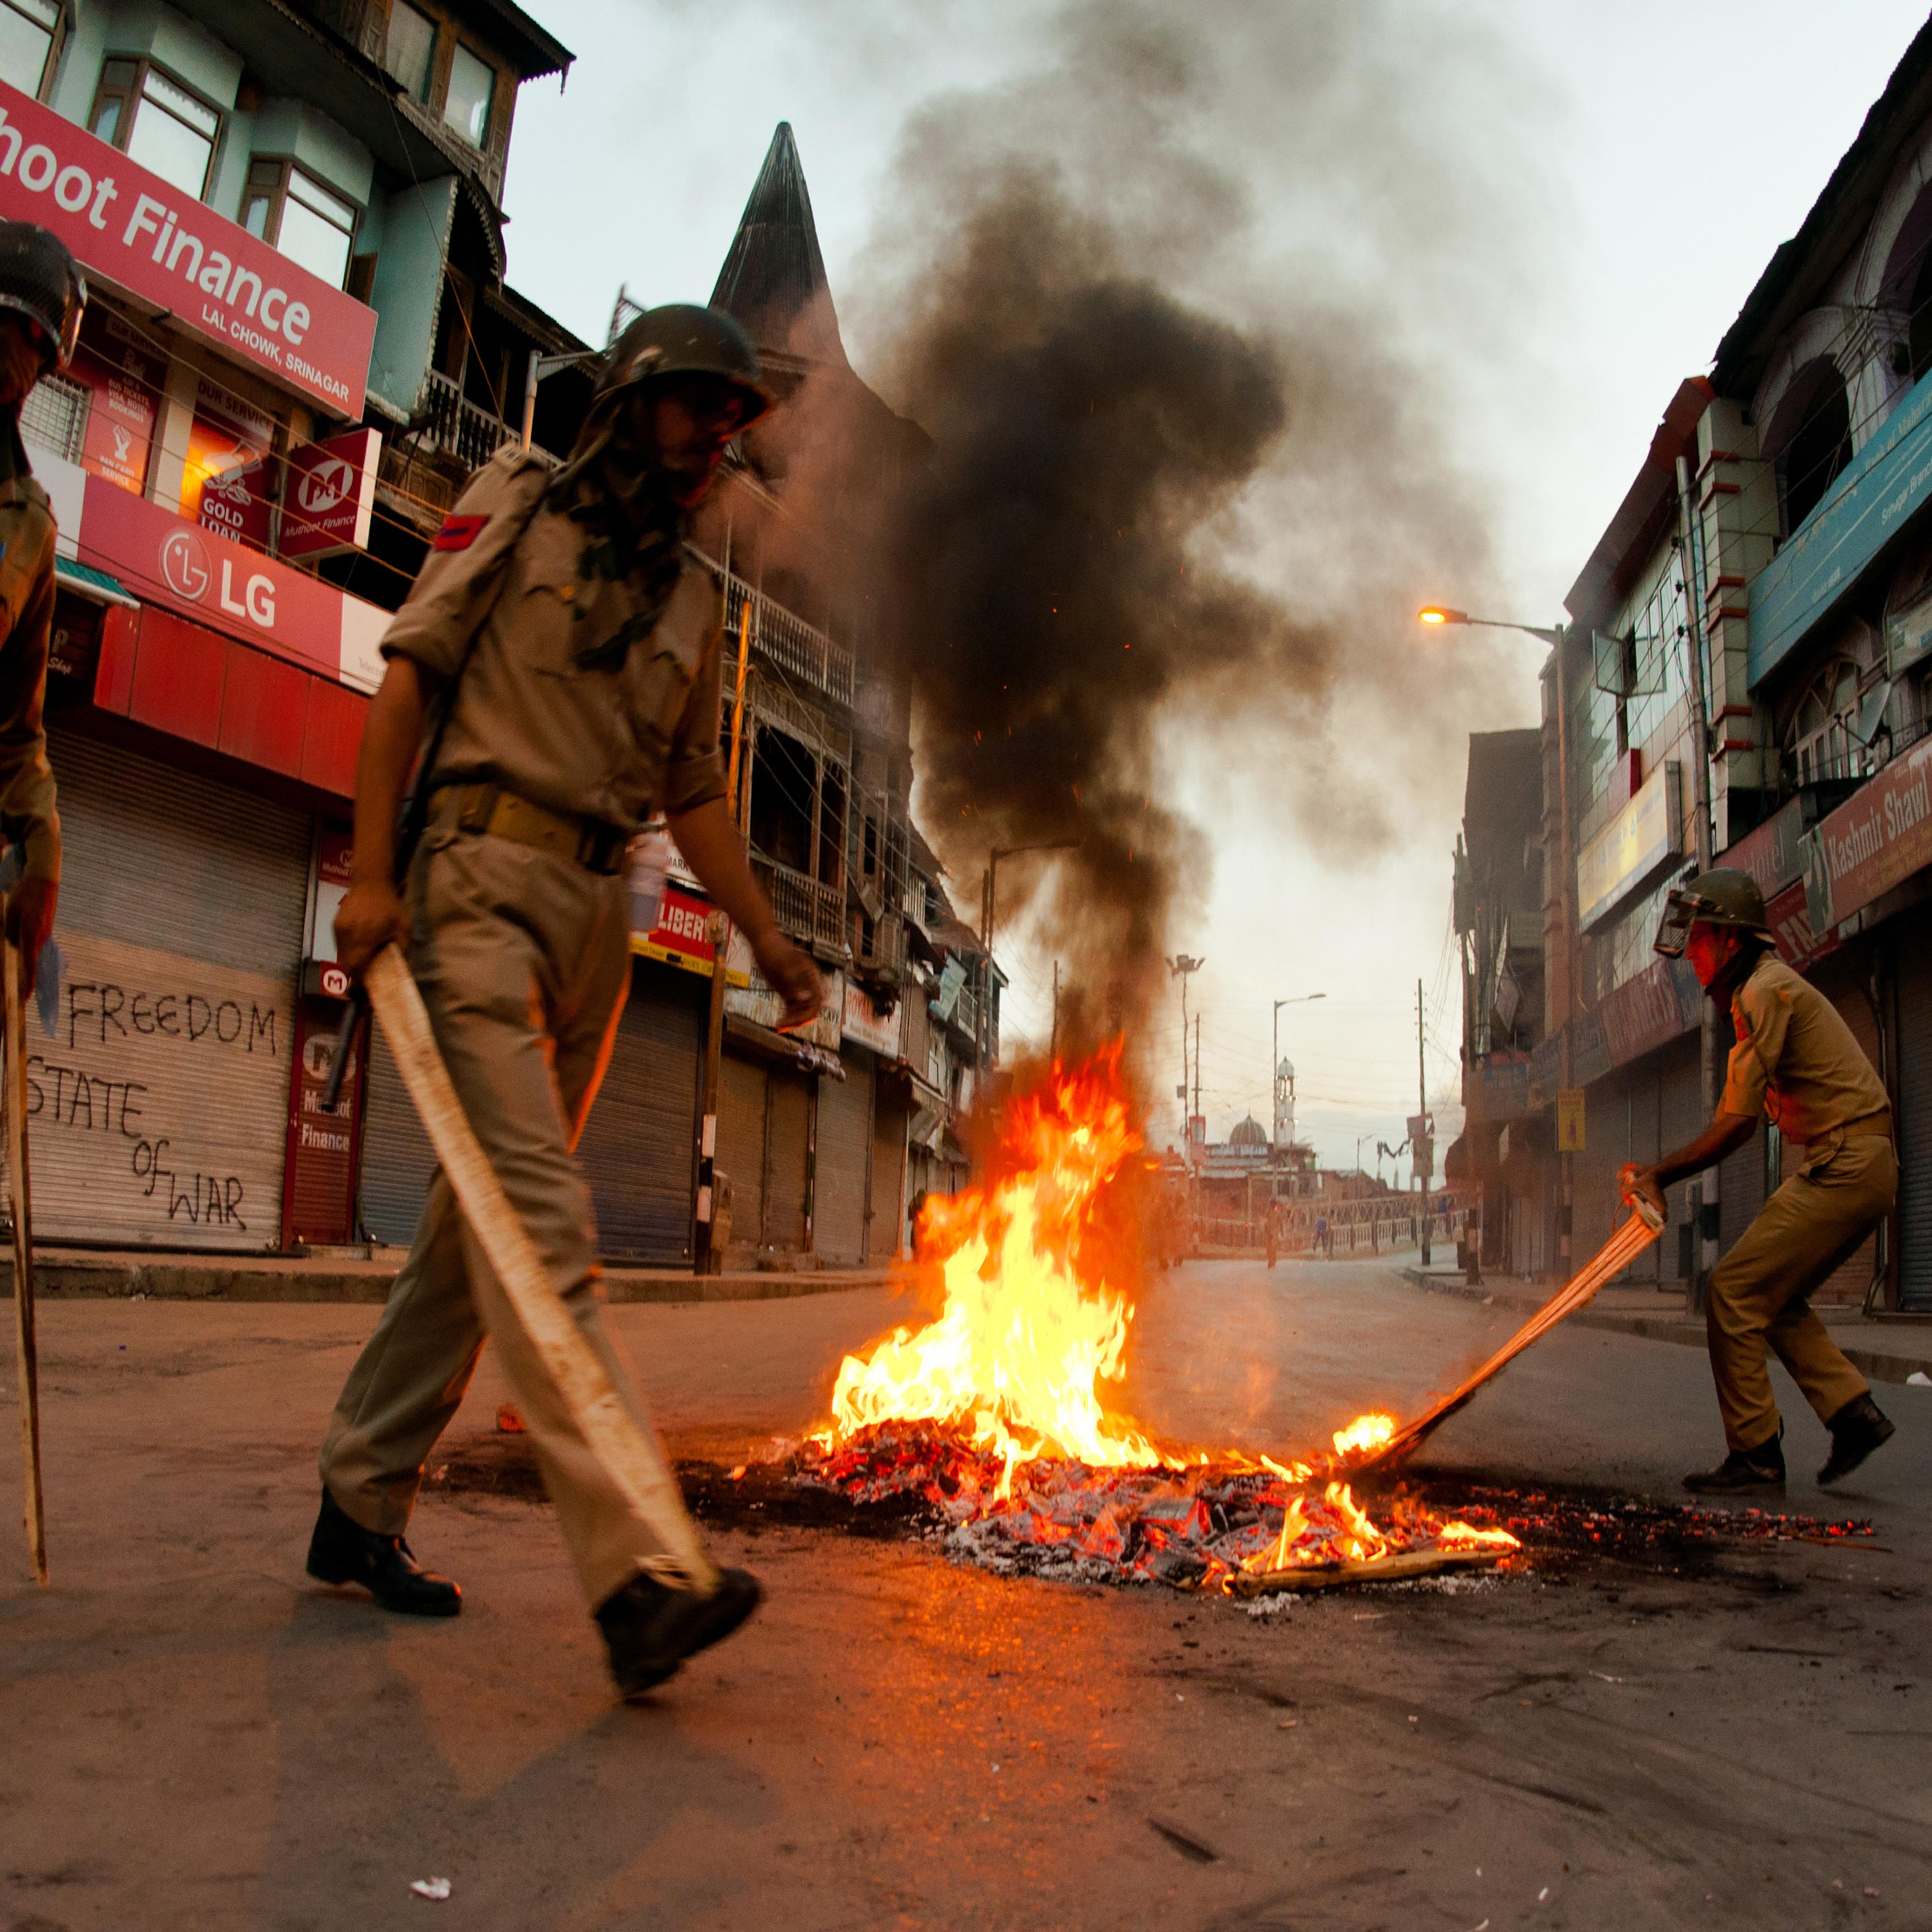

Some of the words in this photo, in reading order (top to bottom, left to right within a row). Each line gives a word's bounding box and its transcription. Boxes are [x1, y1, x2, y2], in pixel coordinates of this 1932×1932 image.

[122, 192, 310, 346] Finance
[202, 304, 227, 333] LAL
[230, 321, 282, 367] CHOWK,
[285, 353, 349, 403] SRINAGAR
[108, 379, 122, 391] BUS
[124, 385, 149, 403] TICKETS
[199, 380, 222, 403] OUR
[109, 399, 144, 422] BOOKINGS
[128, 399, 149, 414] HOTEL
[100, 455, 114, 467] PAN
[116, 463, 135, 477] CARD
[102, 466, 129, 486] SERVICE
[204, 498, 243, 528] GOLD
[1882, 486, 1909, 525] Srinagar
[285, 521, 321, 537] Muthoot
[322, 515, 356, 529] Finance
[221, 559, 276, 628] LG
[47, 657, 71, 675] Shop
[1828, 805, 1883, 881] Kashmir
[1884, 767, 1931, 841] Shawl
[657, 903, 707, 943] LIBER
[68, 983, 275, 1056] FREEDOM
[27, 1055, 148, 1138] STATE
[302, 1123, 350, 1152] Finance
[168, 1172, 247, 1231] WAR
